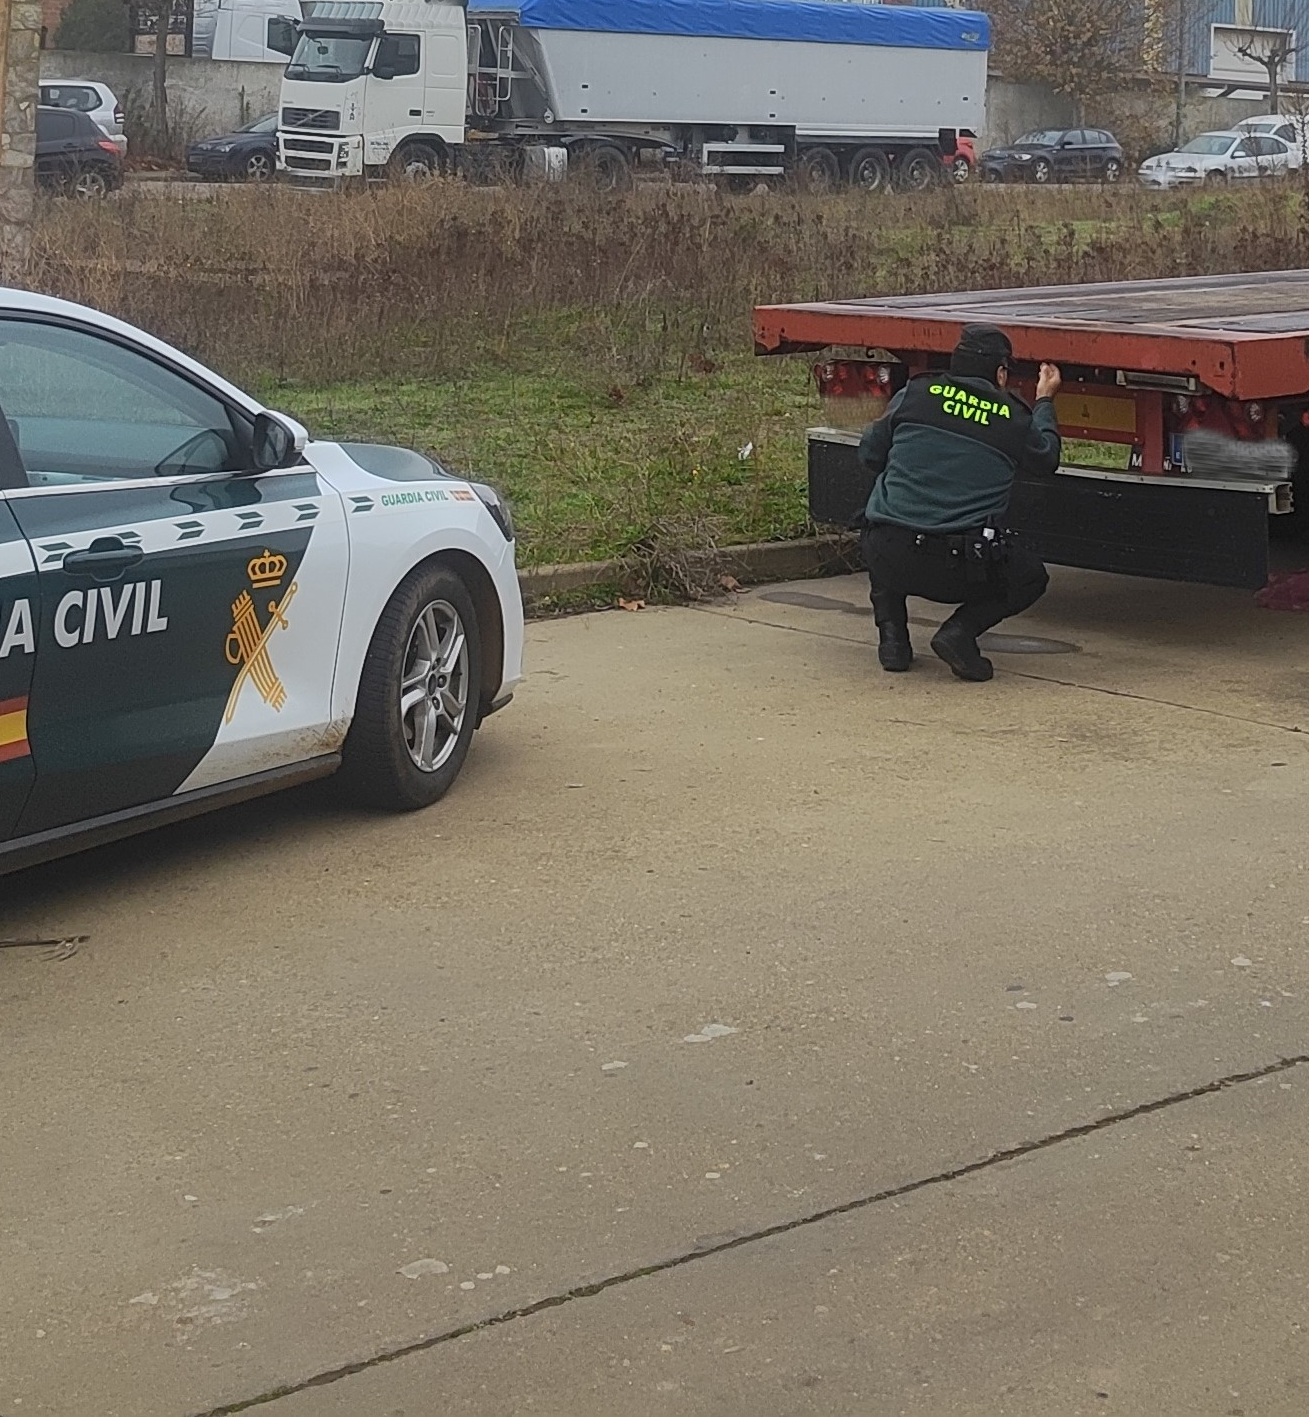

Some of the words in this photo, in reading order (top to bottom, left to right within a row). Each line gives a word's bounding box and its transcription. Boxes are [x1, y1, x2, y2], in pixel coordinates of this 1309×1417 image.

[929, 385, 1010, 419] GUARDIA
[942, 400, 989, 425] CIVIL
[381, 491, 424, 507] GUARDIA
[425, 490, 448, 502] CIVIL
[54, 579, 168, 648] CIVIL
